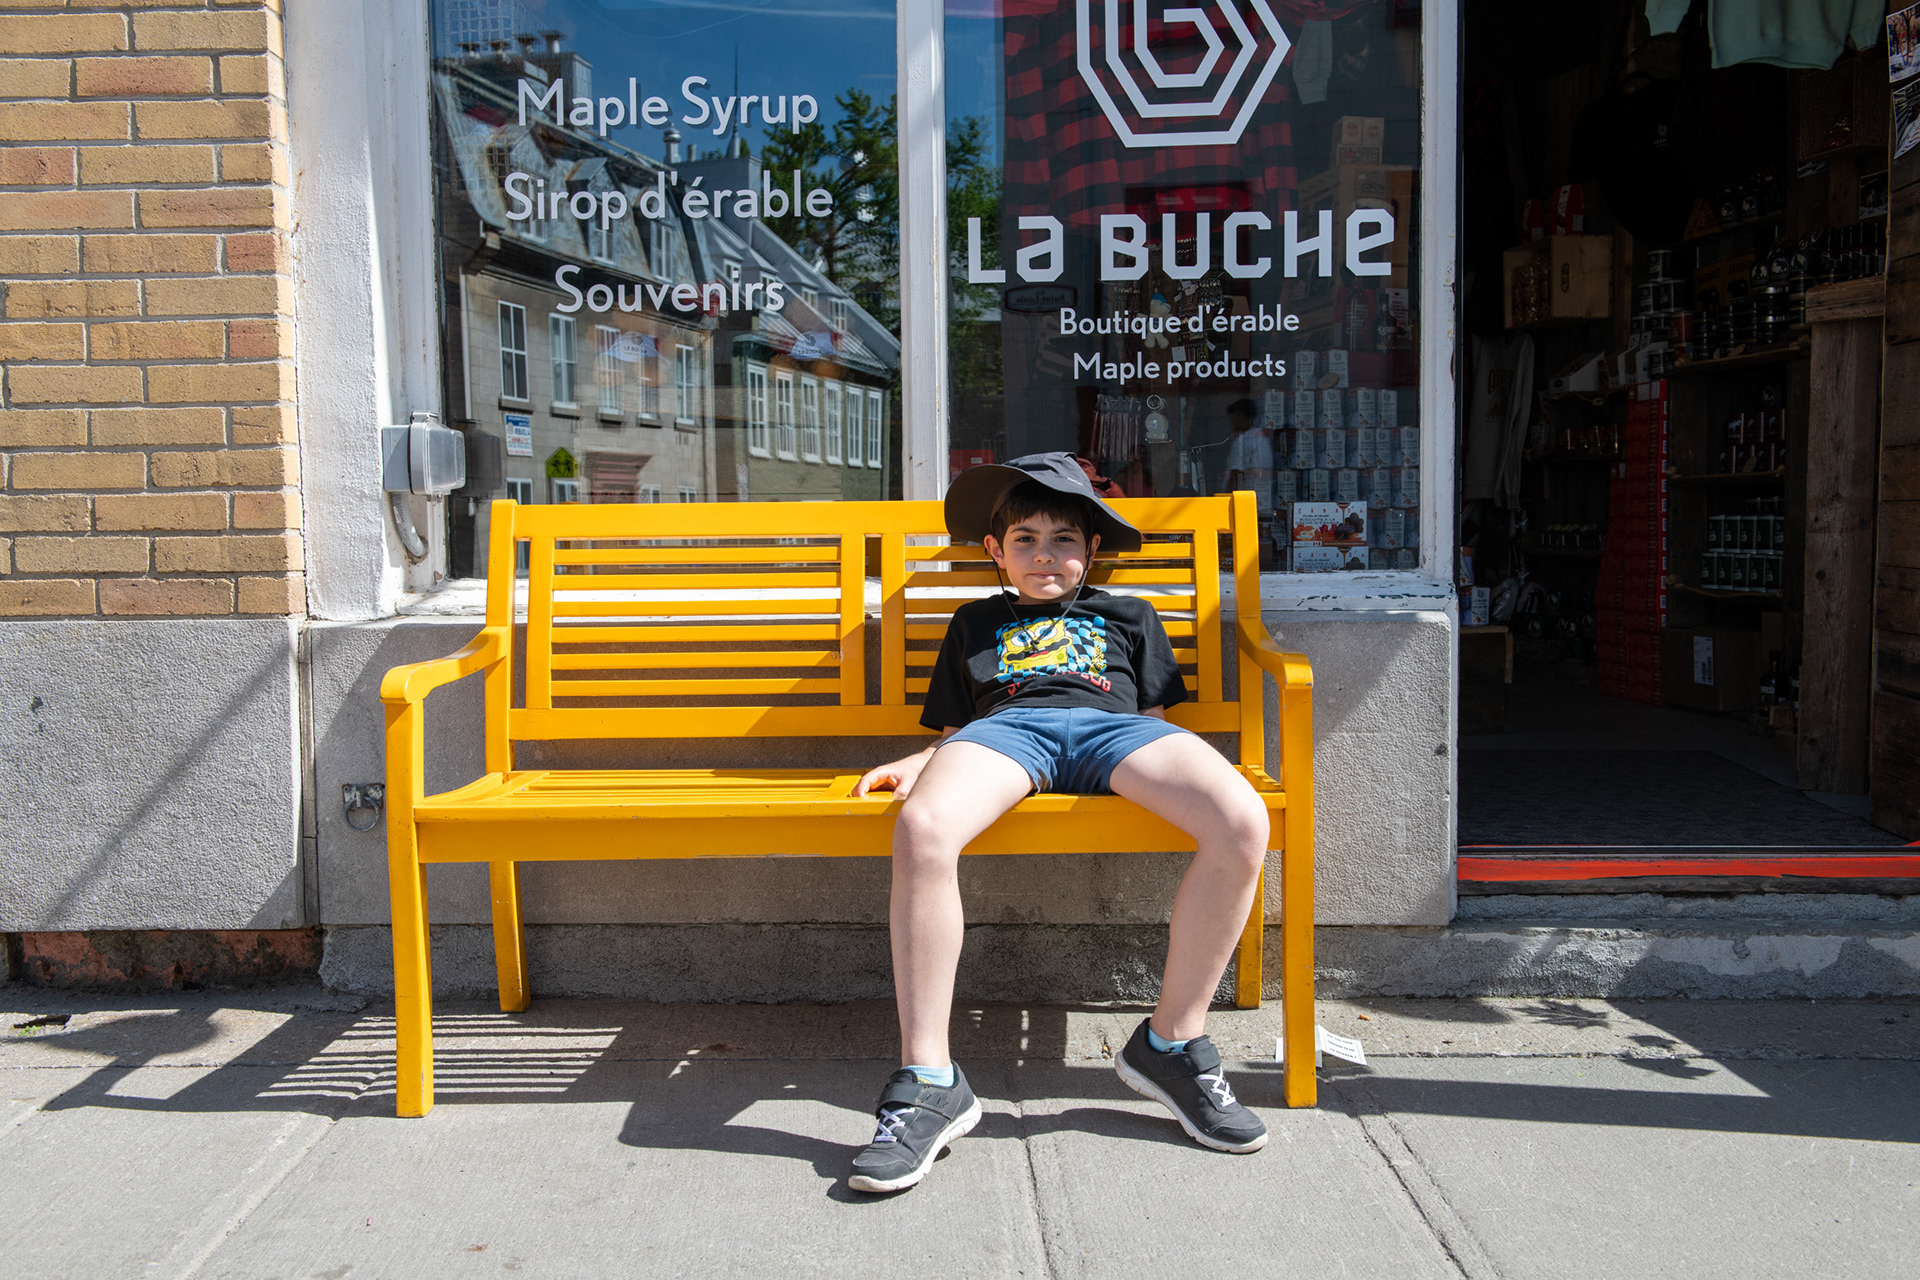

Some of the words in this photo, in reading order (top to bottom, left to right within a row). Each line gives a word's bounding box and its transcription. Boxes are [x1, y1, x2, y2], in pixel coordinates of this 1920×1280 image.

[518, 77, 669, 136] Maple
[681, 75, 818, 135] Syrup
[504, 171, 628, 231] Sirop
[639, 169, 833, 219] d'érable
[555, 264, 785, 313] Souvenirs
[1060, 307, 1181, 340] Boutique
[1188, 303, 1300, 333] d'érable
[1074, 351, 1160, 385] Maple
[1167, 350, 1286, 384] products
